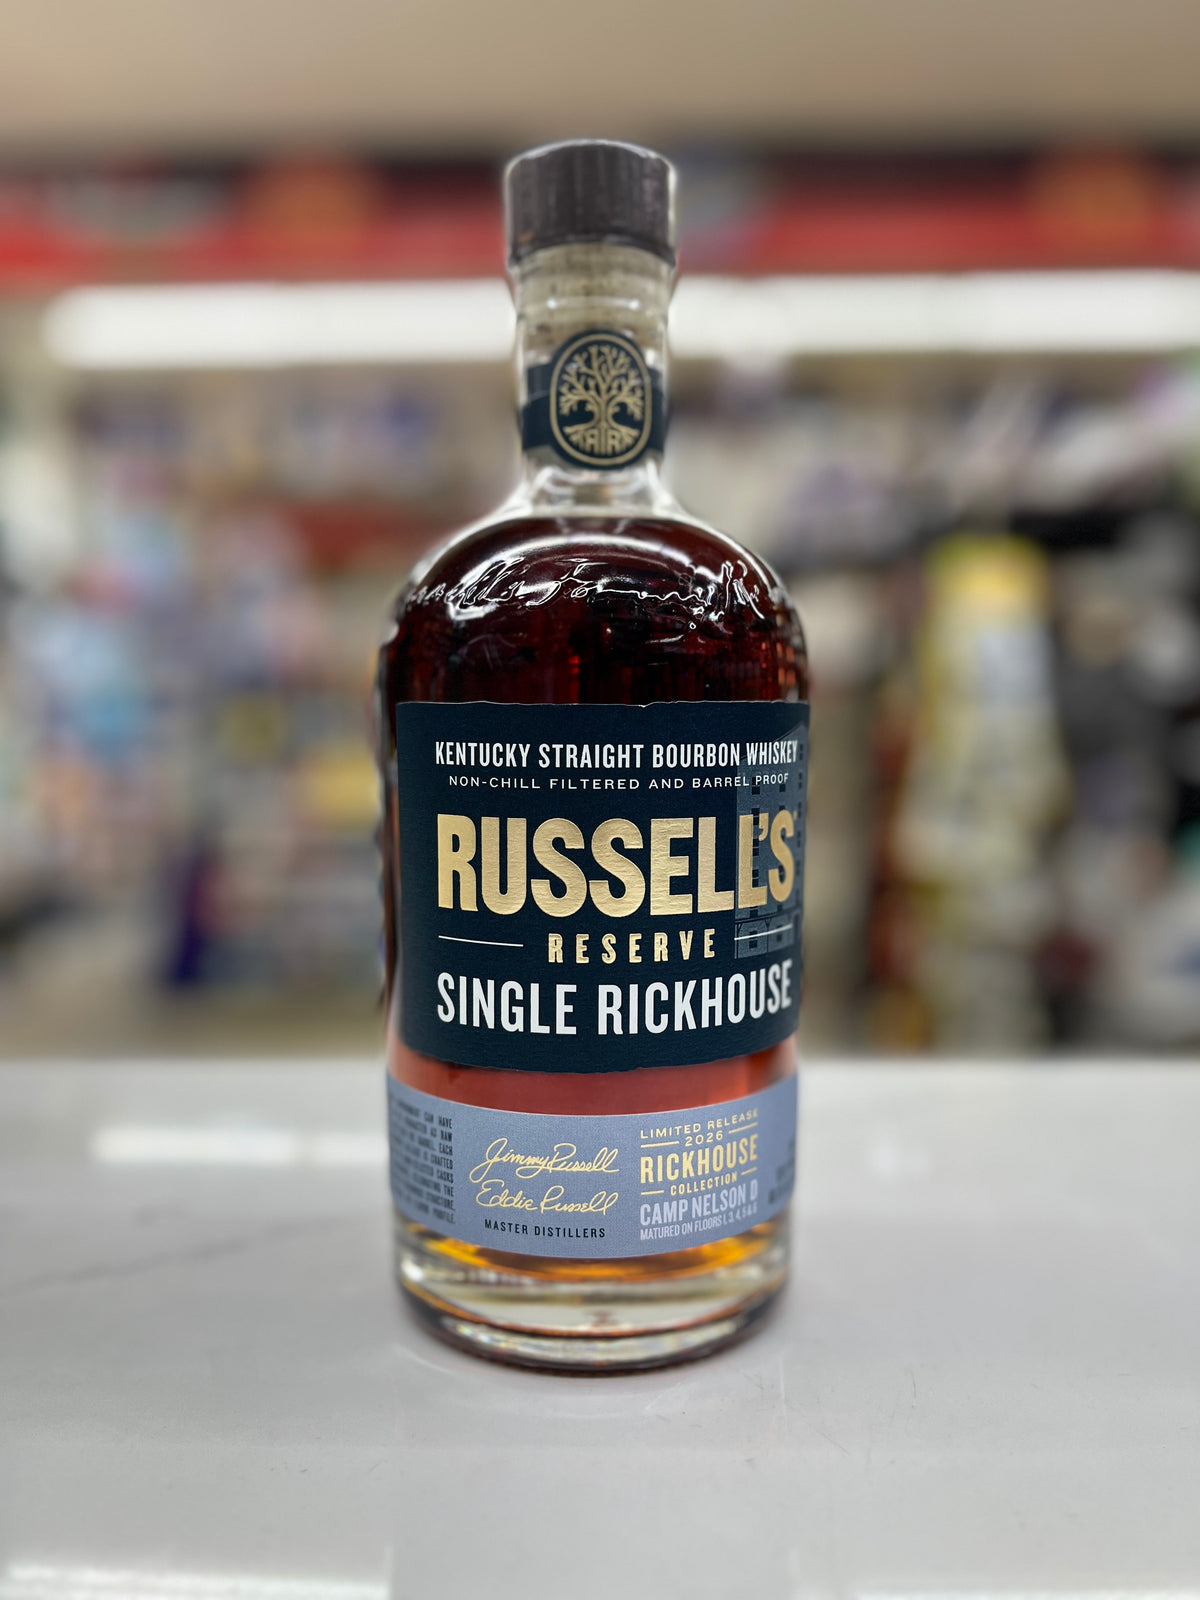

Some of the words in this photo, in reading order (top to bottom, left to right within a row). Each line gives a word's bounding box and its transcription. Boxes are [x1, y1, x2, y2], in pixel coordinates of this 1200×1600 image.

[435, 741, 531, 768] KENTUCKY
[538, 743, 644, 769] STRAIGHT
[652, 743, 740, 769] BOURBON
[746, 740, 798, 766] WHISKEY
[449, 775, 541, 789] NON-CHILL
[549, 778, 640, 790] FILTERED
[649, 778, 684, 790] AND
[692, 775, 750, 788] BARREL
[755, 772, 789, 786] PROOF
[437, 809, 795, 919] RUSSELL'S
[547, 928, 716, 964] RESERVE
[436, 972, 578, 1036] SINGLE
[598, 959, 793, 1036] RICKHOUSE
[438, 1115, 453, 1129] HAVE
[640, 1123, 701, 1139] LIMITED
[707, 1107, 758, 1130] RELEASE
[438, 1142, 453, 1156] EACH
[685, 1130, 723, 1147] 2026
[430, 1153, 454, 1170] CRAFTED
[469, 1137, 550, 1184] Jimmy
[547, 1142, 620, 1174] Russell
[640, 1133, 758, 1184] RICKHOUSE
[475, 1179, 538, 1212] Eddie
[540, 1185, 619, 1216] Russell
[670, 1171, 738, 1196] COLLECTION
[640, 1199, 689, 1226] CAMP
[691, 1184, 747, 1219] NELSON
[749, 1178, 759, 1201] D
[484, 1219, 529, 1235] MASTER
[534, 1226, 606, 1239] DISTILLERS
[640, 1224, 680, 1241] MATURED
[681, 1221, 694, 1236] ON
[694, 1214, 722, 1233] FLOORS
